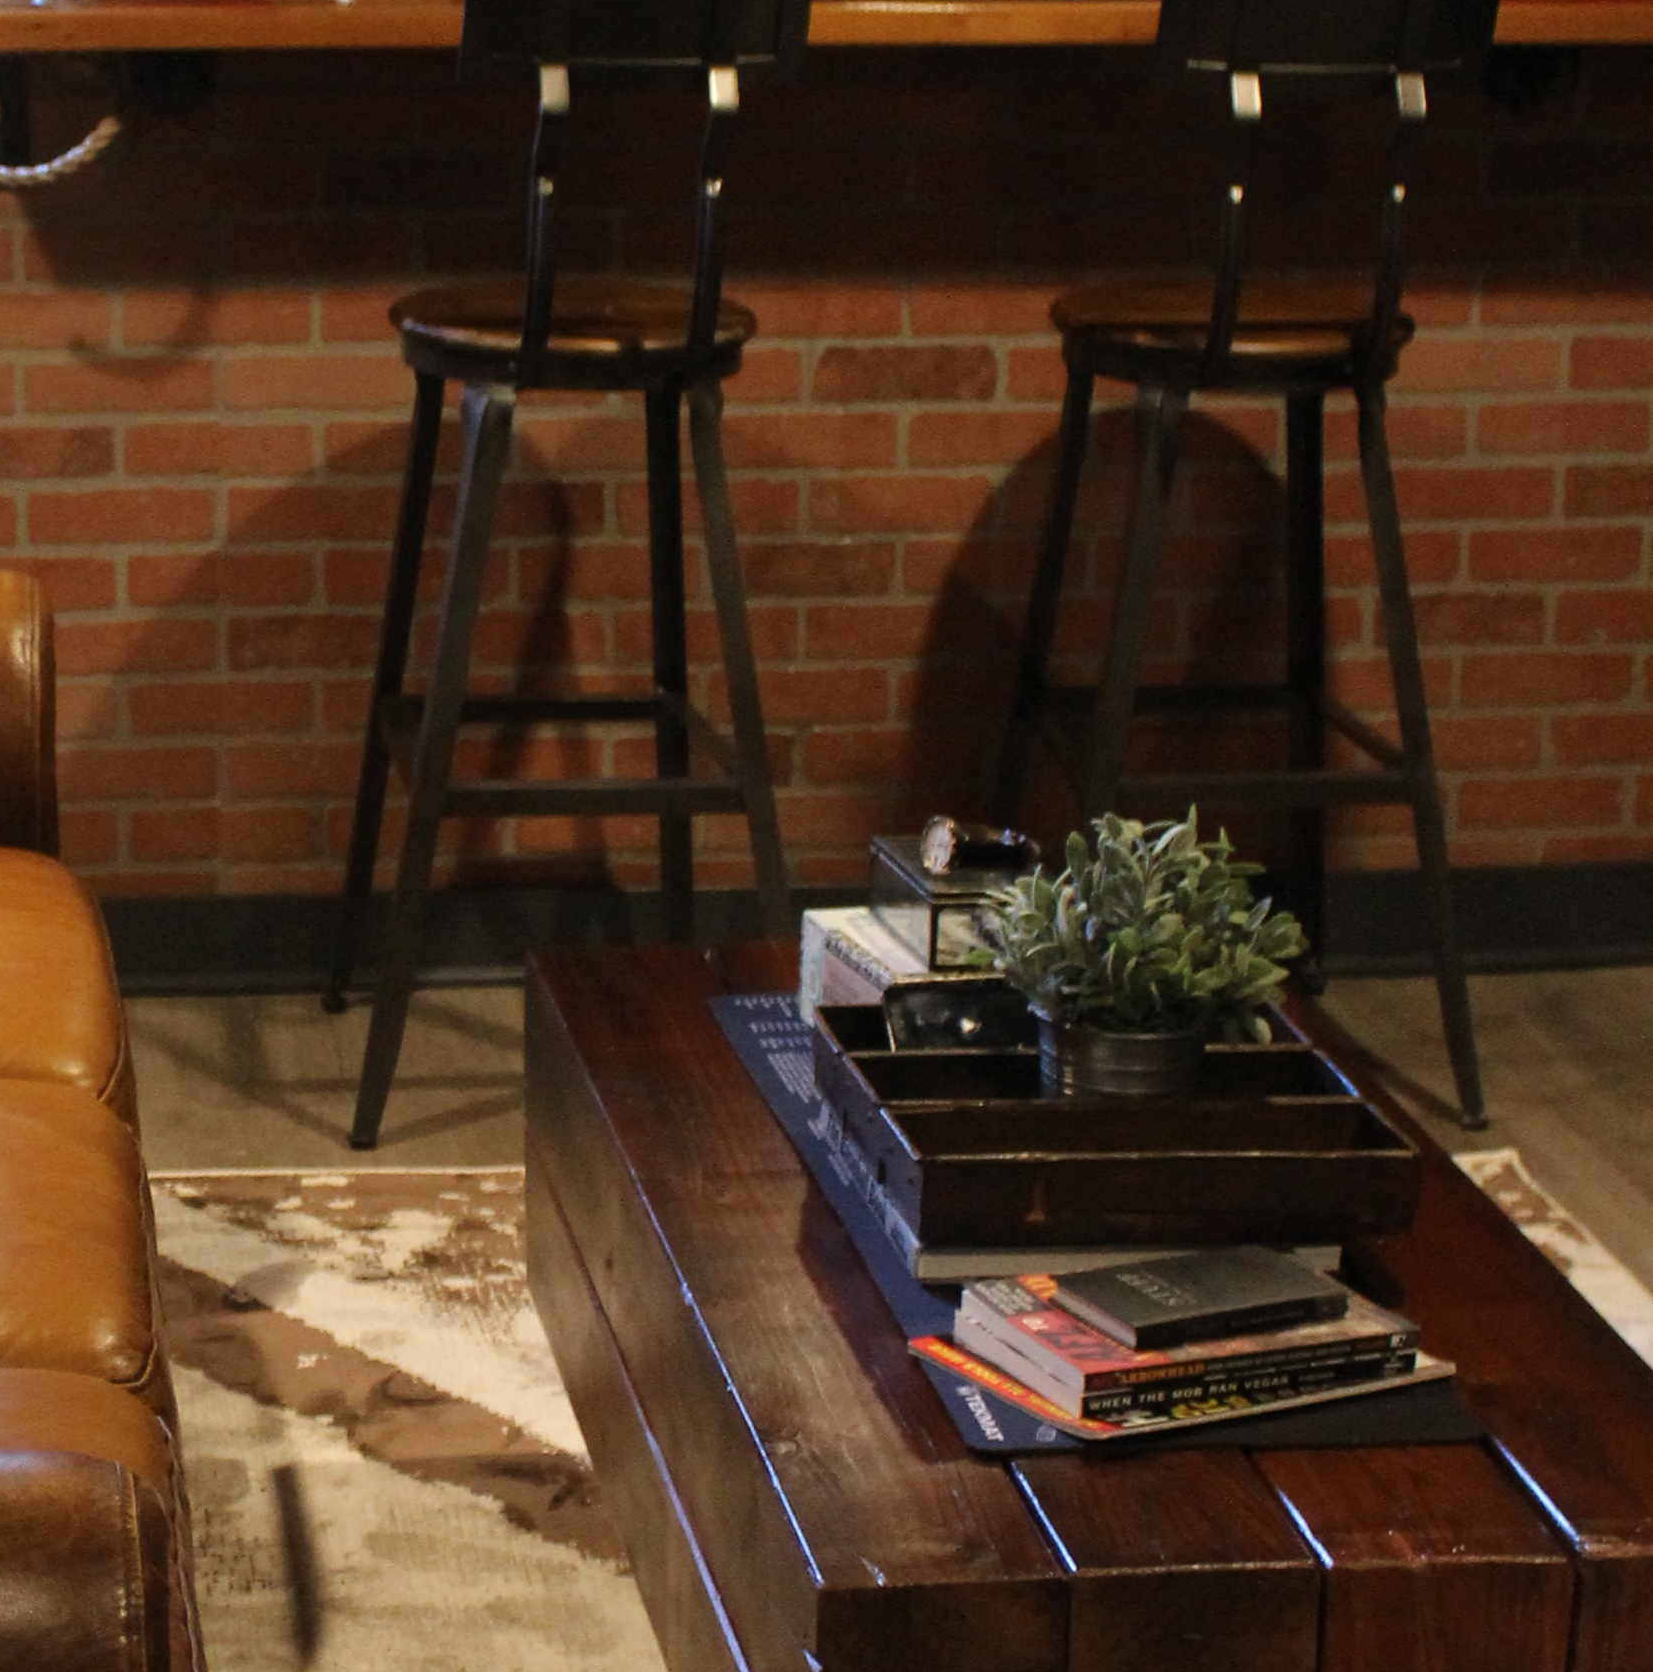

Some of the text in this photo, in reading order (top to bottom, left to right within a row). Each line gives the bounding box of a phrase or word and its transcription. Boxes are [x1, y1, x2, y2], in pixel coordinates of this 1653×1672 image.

[1088, 1396, 1132, 1411] WHEN
[1138, 1390, 1165, 1404] THE
[1172, 1386, 1204, 1400] MOB
[1209, 1382, 1238, 1395] RAN
[1244, 1376, 1290, 1391] VEGAS
